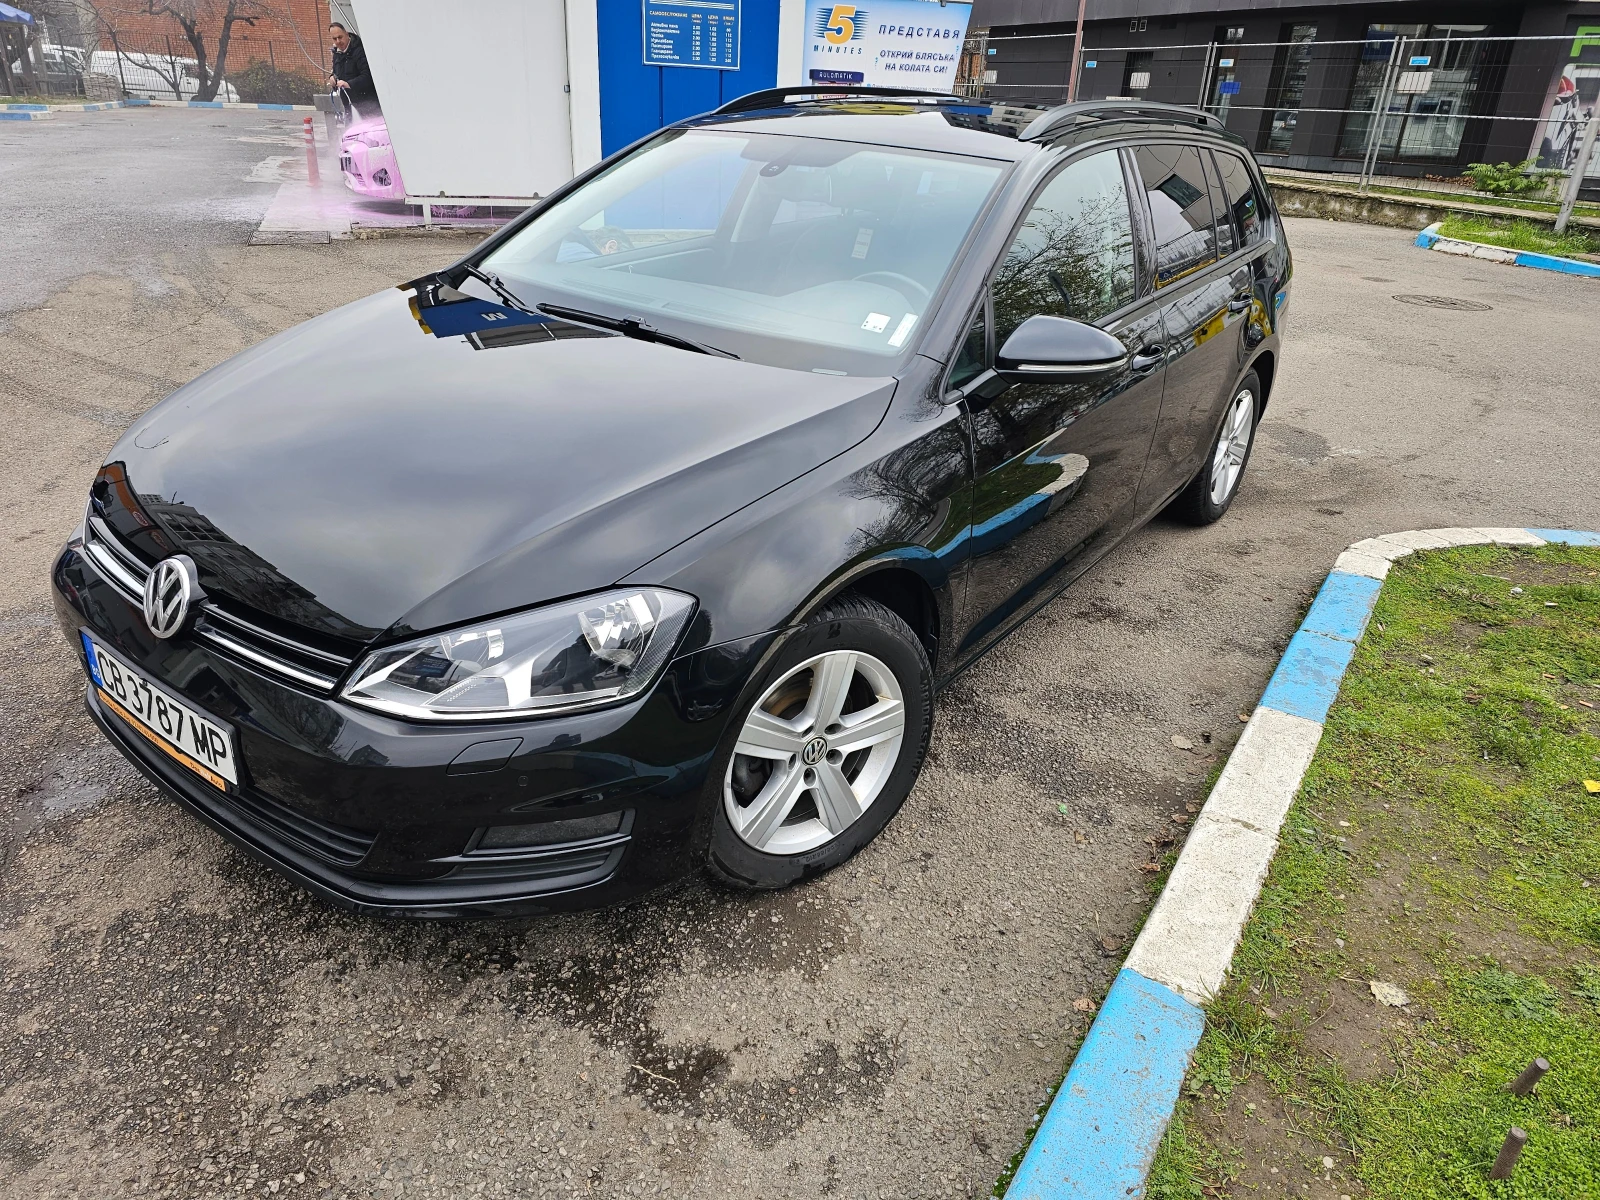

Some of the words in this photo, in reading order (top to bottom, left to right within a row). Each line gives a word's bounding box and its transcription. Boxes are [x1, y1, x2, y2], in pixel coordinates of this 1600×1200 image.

[824, 4, 857, 44] 5
[878, 24, 960, 39] ПРЕДСТАВЯ
[814, 45, 863, 55] MINUTES
[880, 49, 914, 59] ОТКРИЙ
[915, 51, 955, 62] БЛЯСЪКА
[884, 63, 896, 71] НА
[899, 64, 931, 73] КОЛАТА
[933, 65, 948, 74] СИ!
[98, 651, 127, 702] CB
[128, 674, 184, 742] 3787
[190, 716, 226, 768] MP
